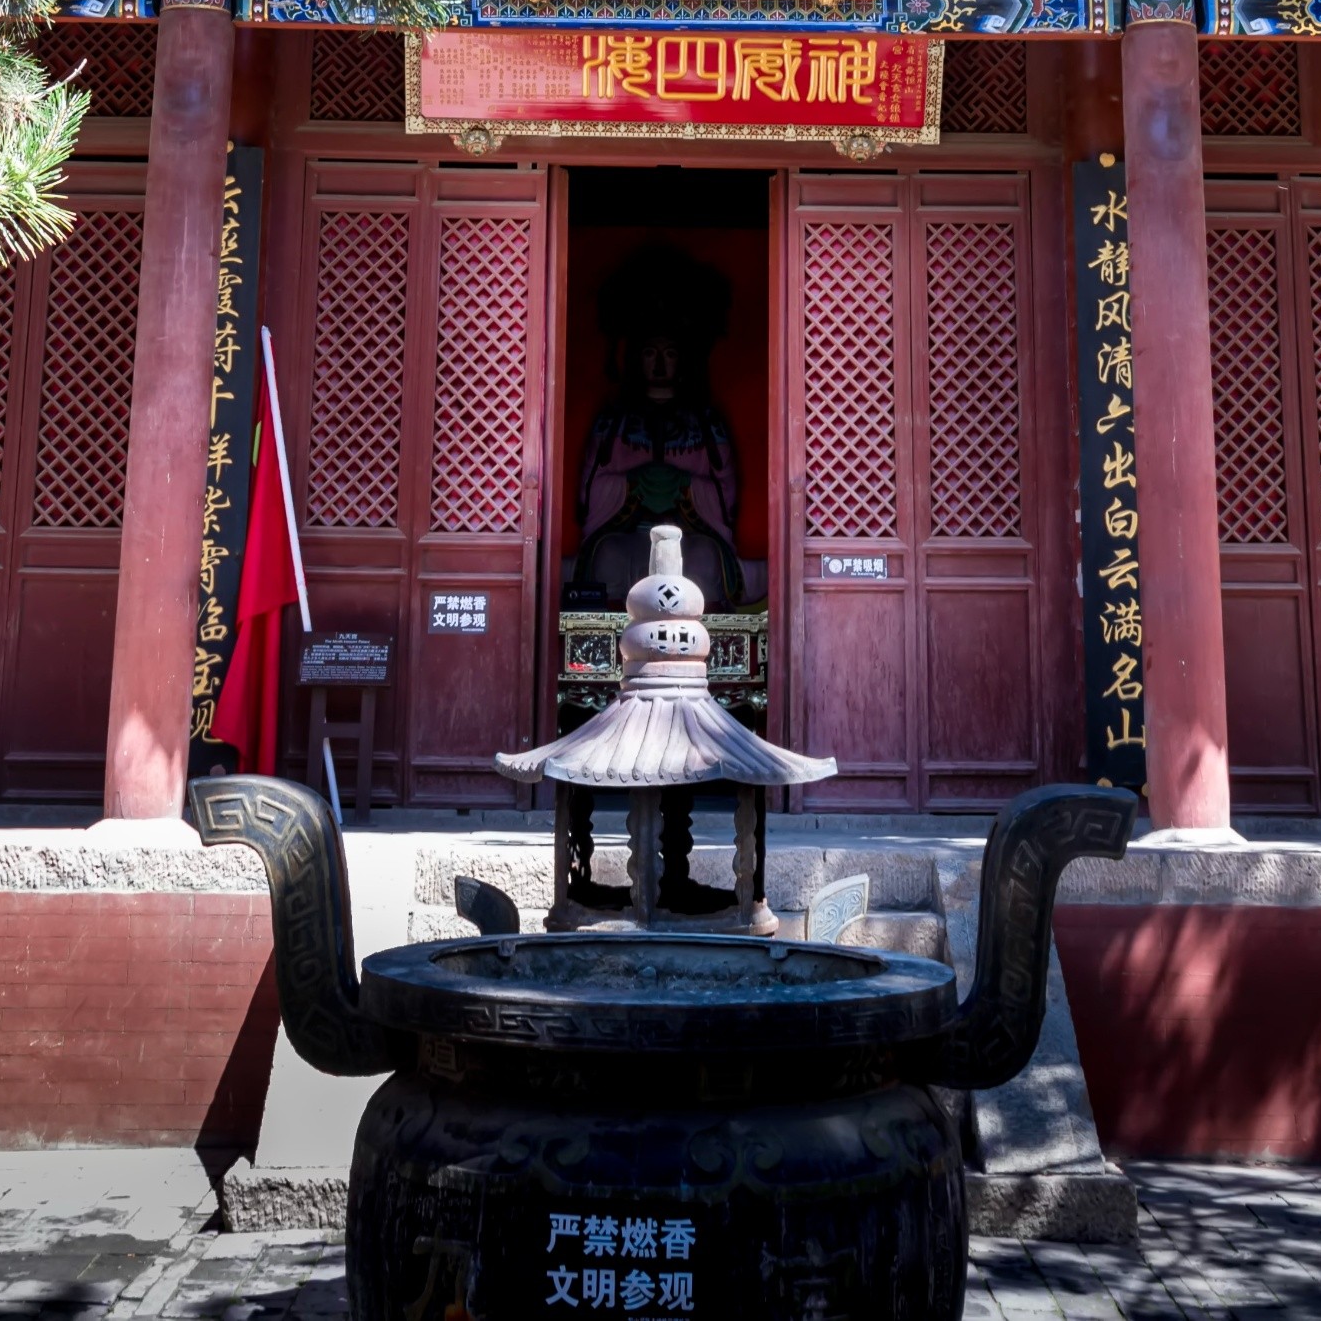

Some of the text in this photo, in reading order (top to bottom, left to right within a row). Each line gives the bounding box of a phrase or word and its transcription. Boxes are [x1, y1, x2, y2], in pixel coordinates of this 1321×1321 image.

[842, 558, 884, 573] 严禁吸烟
[433, 595, 487, 610] 严禁燃香
[433, 612, 486, 627] 文明参观
[546, 1213, 696, 1260] 严禁燃香
[545, 1264, 695, 1311] 文明参观
